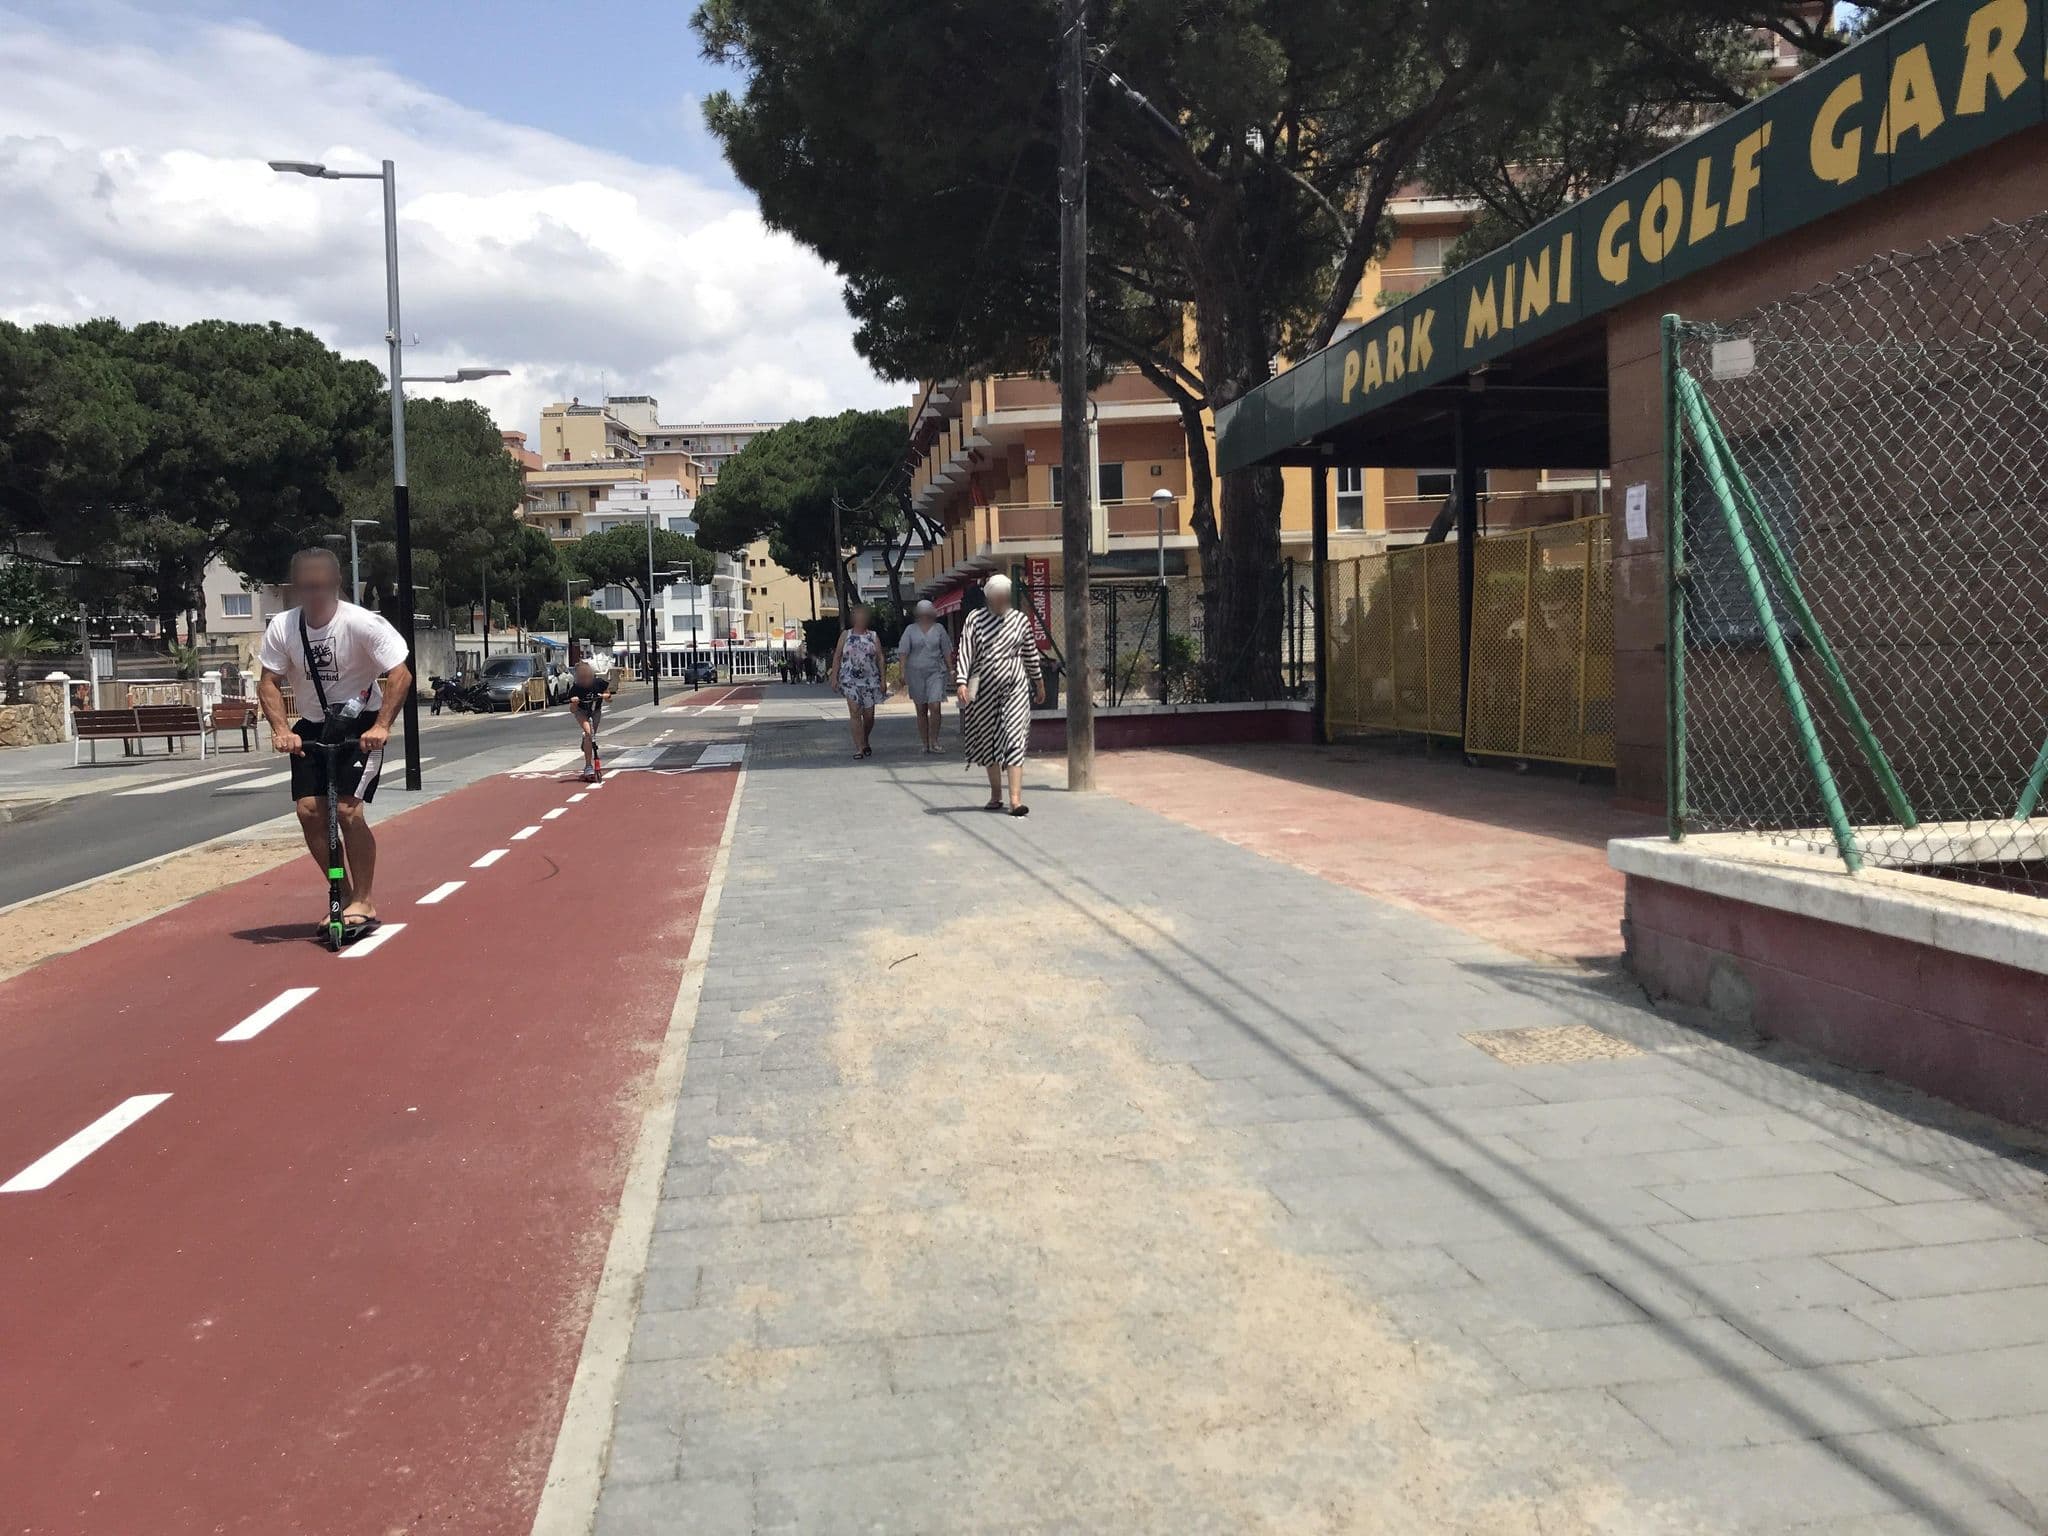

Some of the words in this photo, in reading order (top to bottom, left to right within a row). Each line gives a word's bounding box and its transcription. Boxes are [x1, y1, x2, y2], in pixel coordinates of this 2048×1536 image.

[1342, 308, 1436, 404] PARK
[1463, 231, 1573, 348] MINI
[1597, 119, 1773, 286] GOLF
[1810, 0, 2048, 185] GAR
